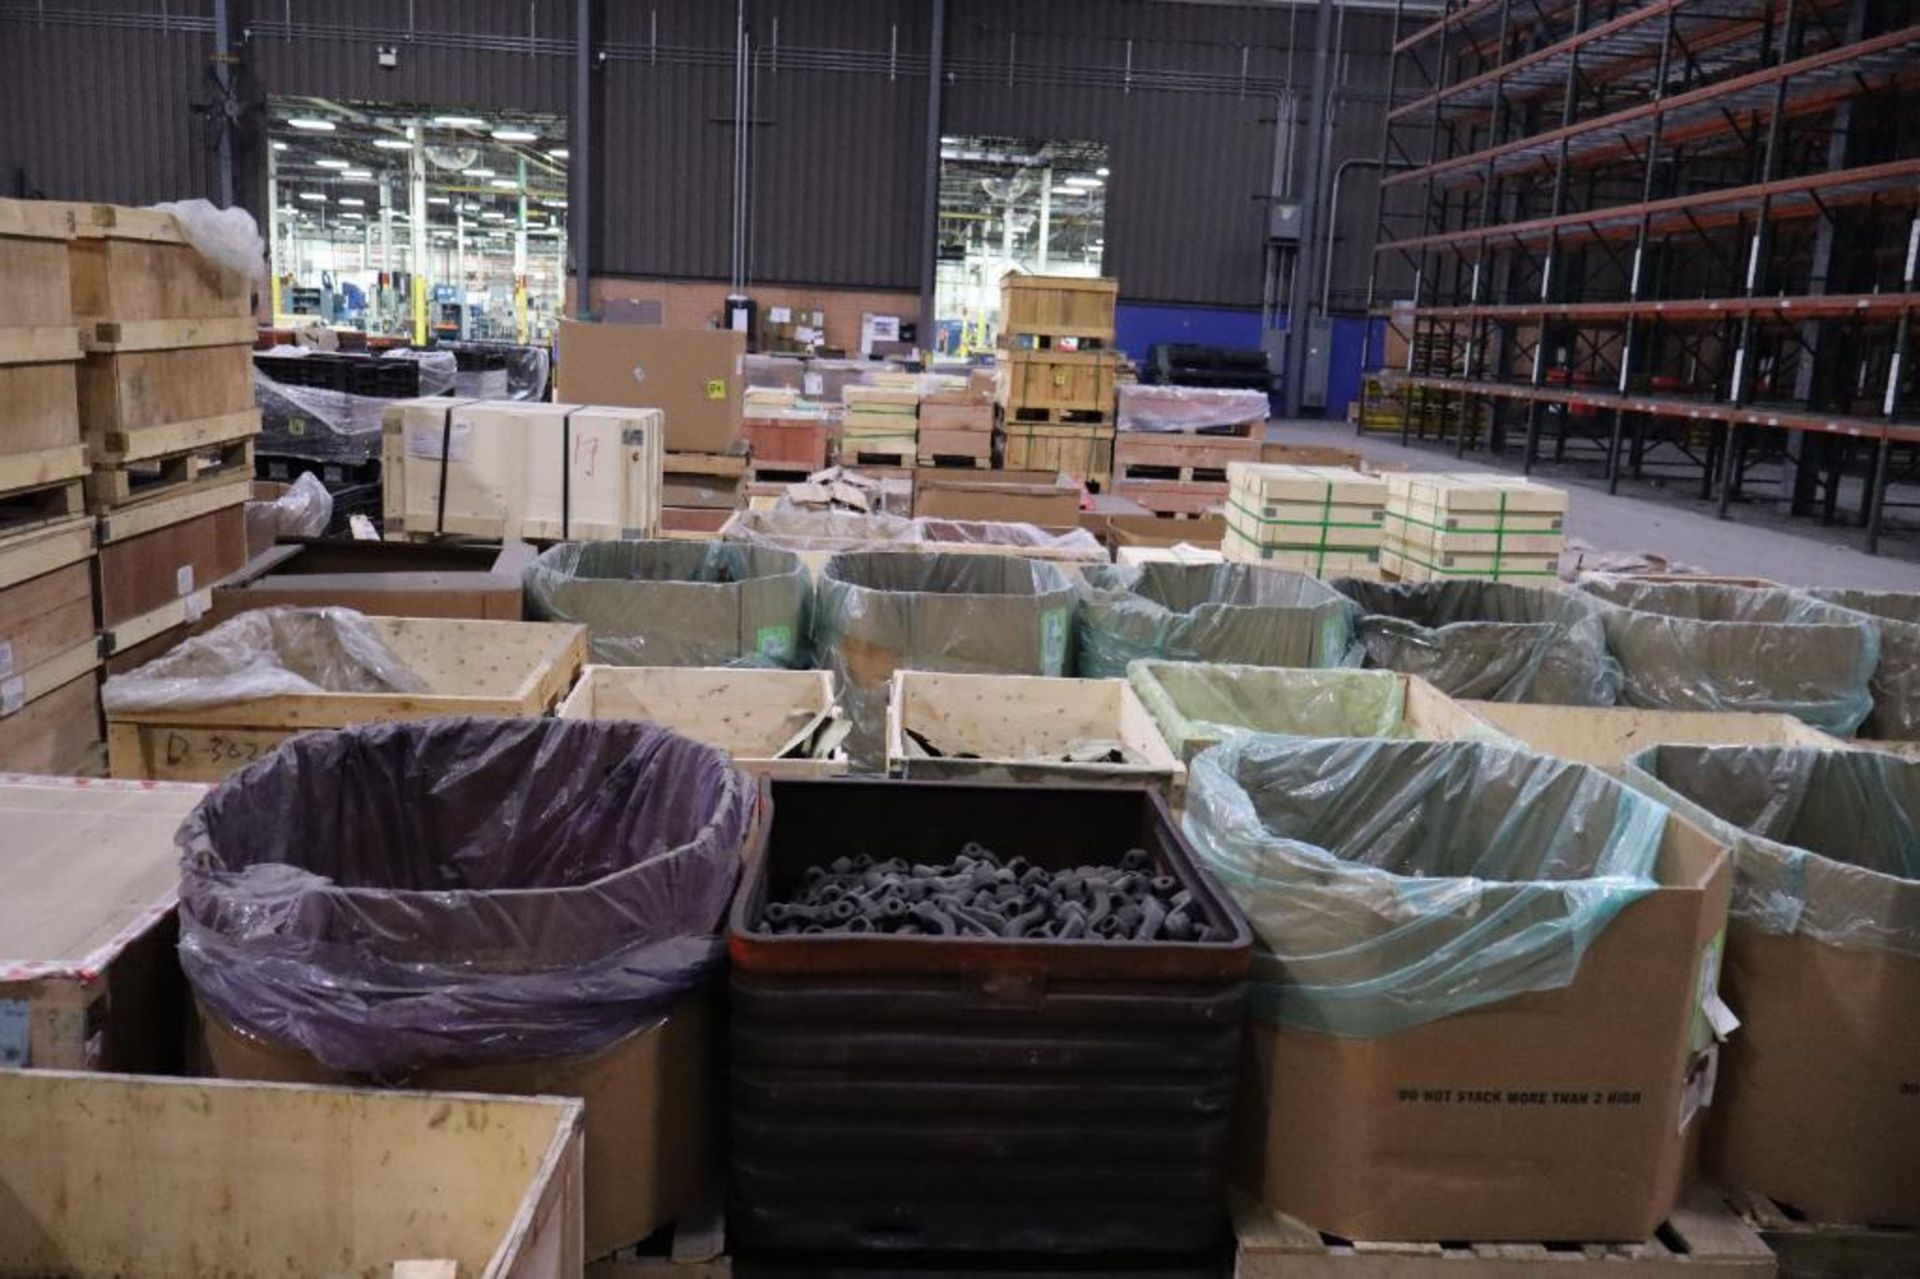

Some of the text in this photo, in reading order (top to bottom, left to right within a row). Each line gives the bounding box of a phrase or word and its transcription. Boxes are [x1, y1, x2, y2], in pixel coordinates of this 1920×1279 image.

[1398, 1089, 1641, 1105] DO NOT STACK MORE THAN 2 HIGH
